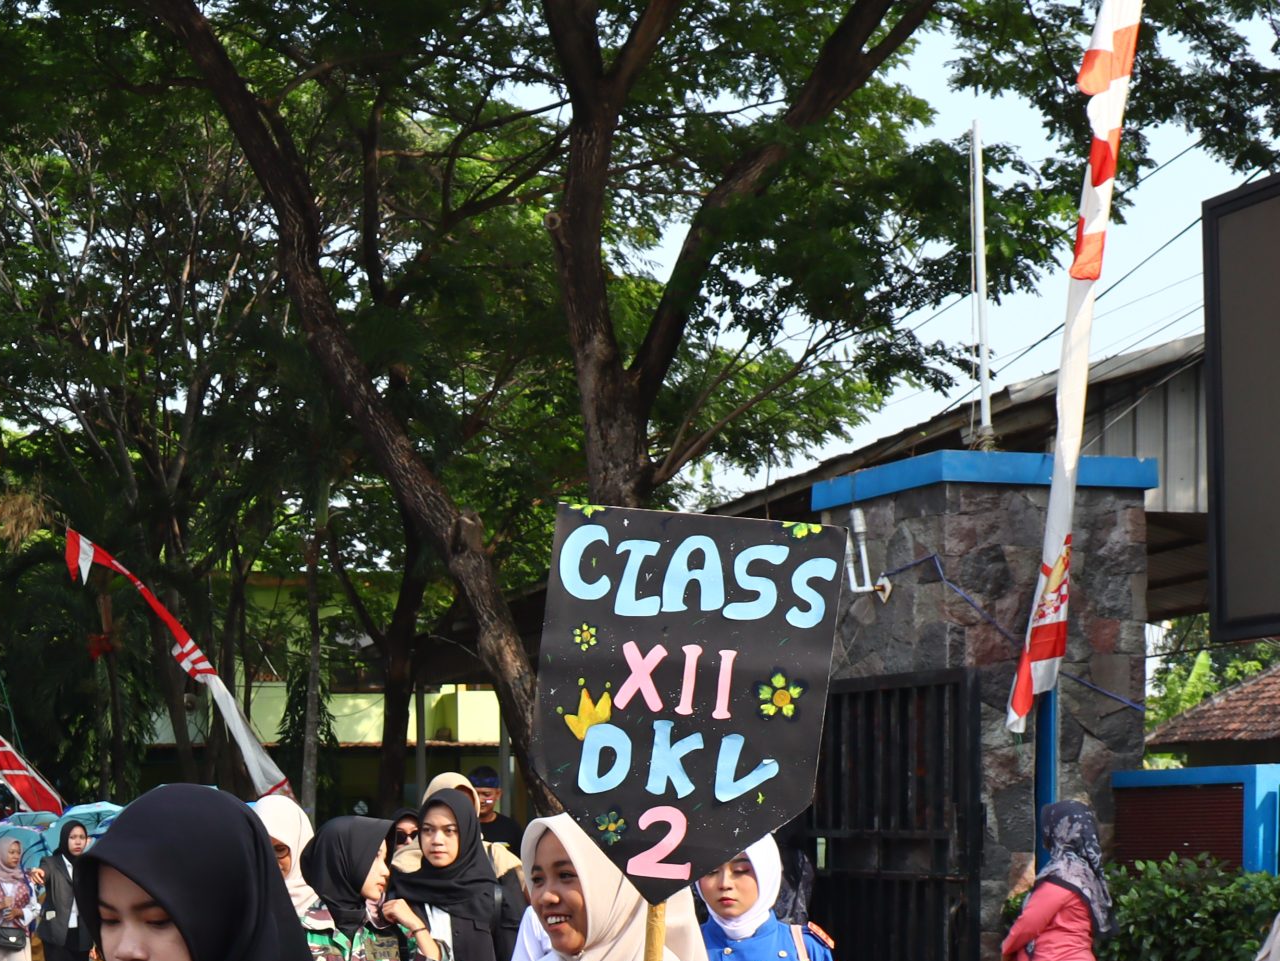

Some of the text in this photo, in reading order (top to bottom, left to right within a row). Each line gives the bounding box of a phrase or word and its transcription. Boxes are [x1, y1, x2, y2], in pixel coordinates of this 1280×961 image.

[558, 524, 838, 629] CLASS
[613, 640, 739, 720] XII
[576, 719, 780, 803] DKV
[625, 805, 692, 881] 2
